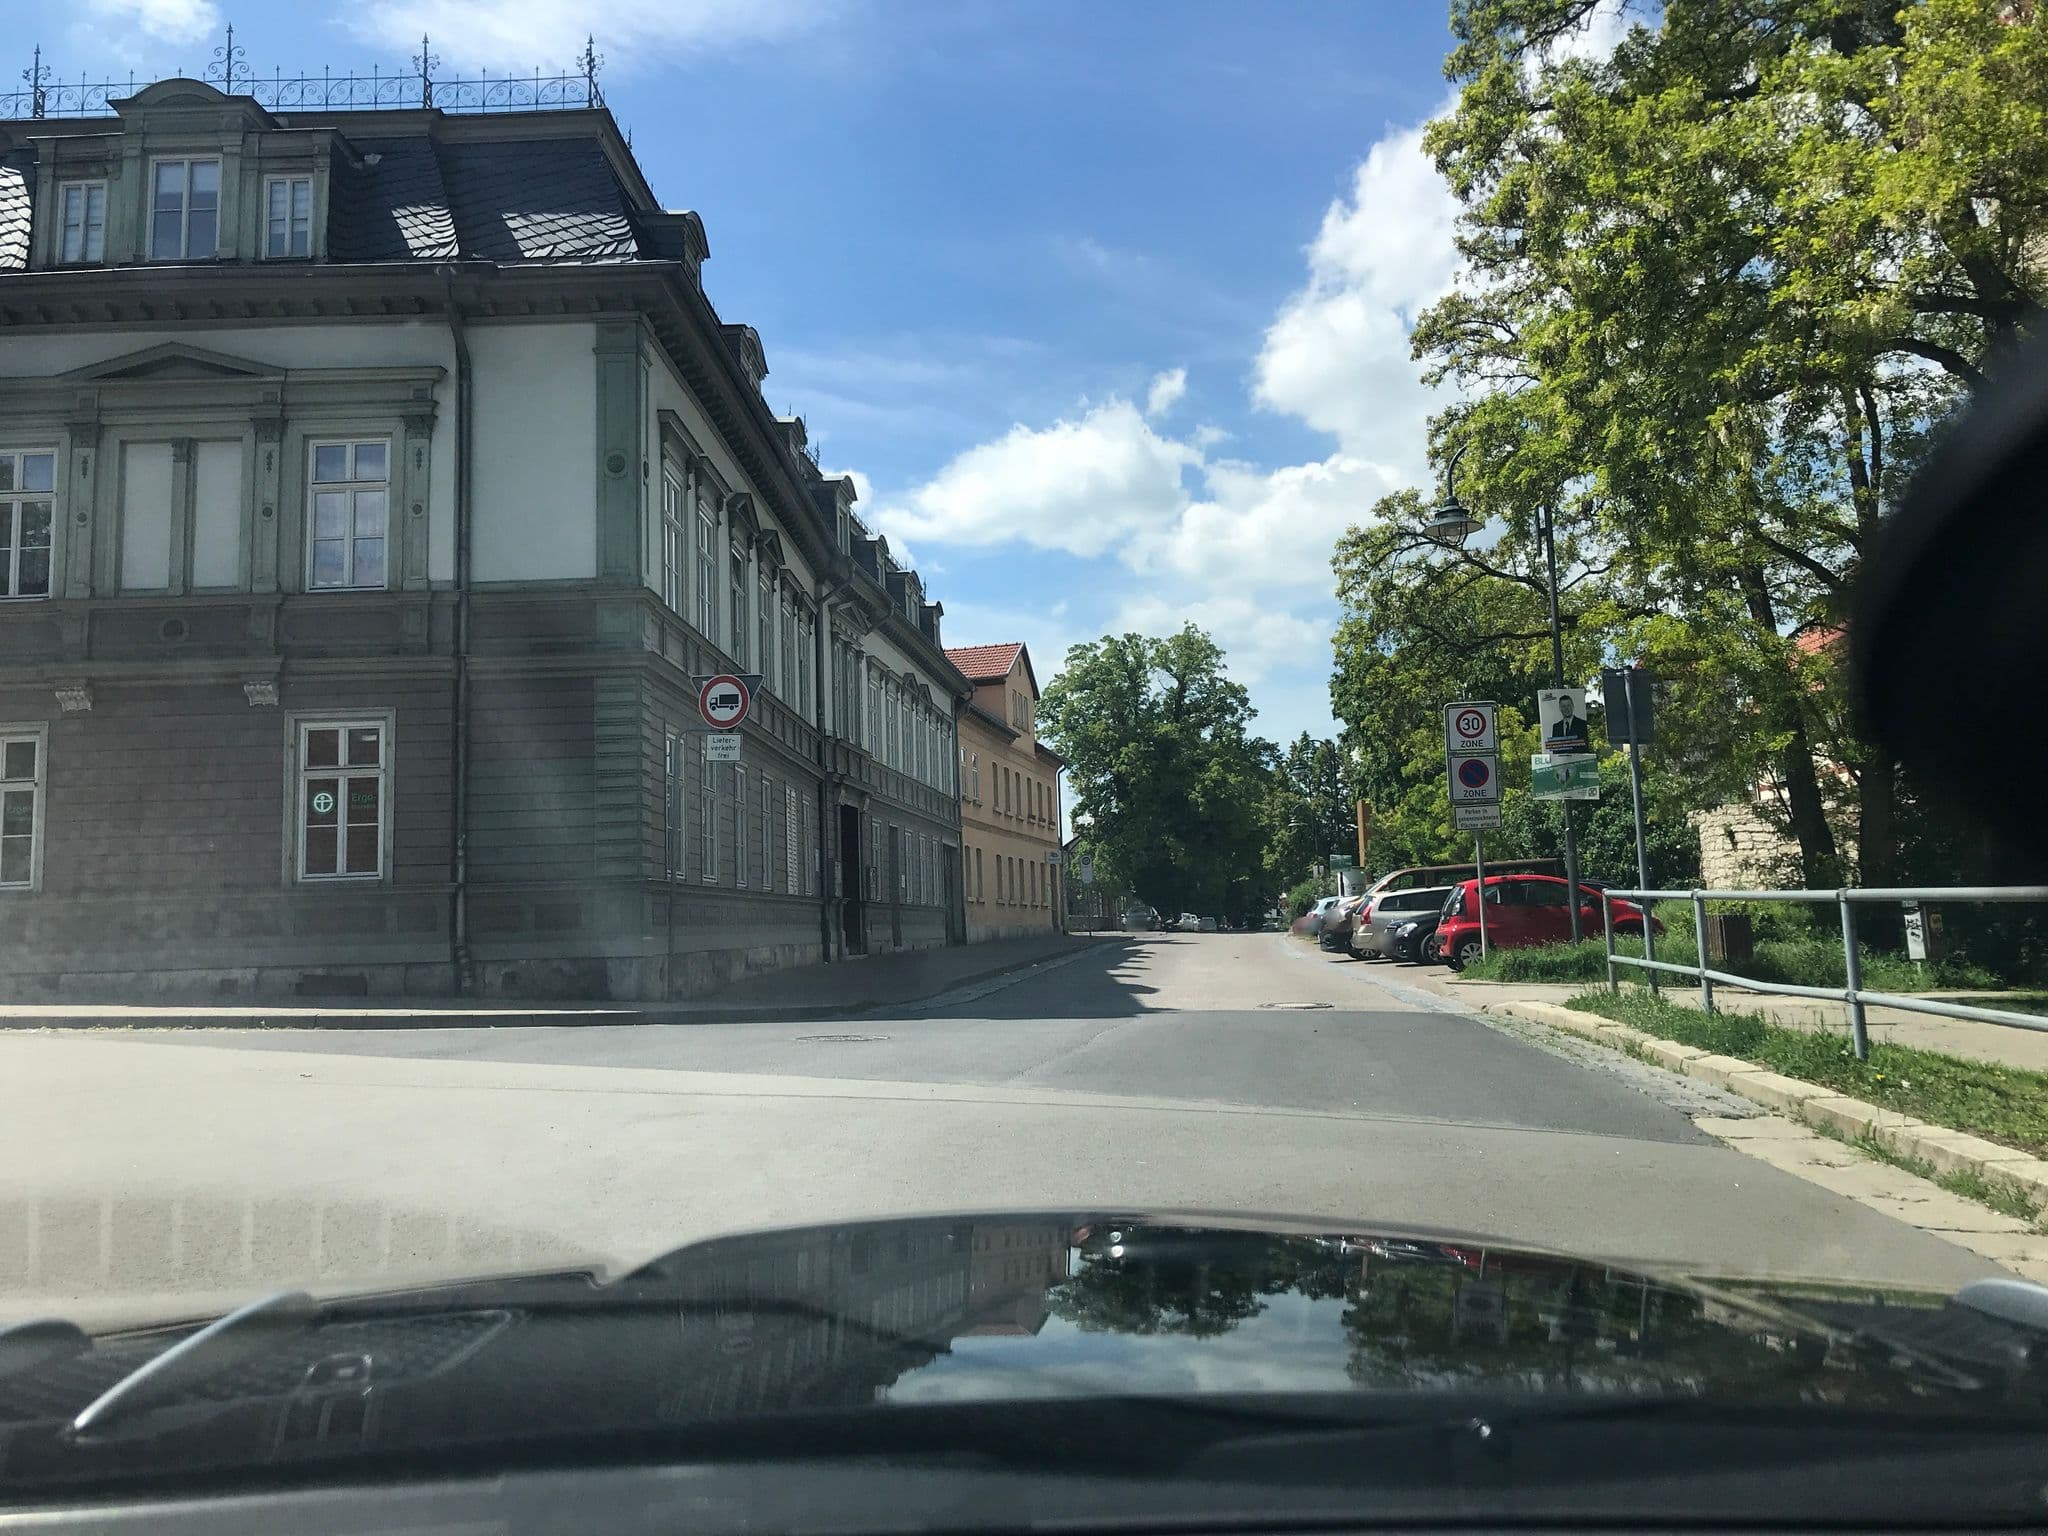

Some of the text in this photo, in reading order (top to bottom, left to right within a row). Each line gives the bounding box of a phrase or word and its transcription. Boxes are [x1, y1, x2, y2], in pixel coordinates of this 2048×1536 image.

[1462, 717, 1480, 731] 30
[1460, 739, 1484, 748] ZONE
[1463, 789, 1487, 798] ZONE
